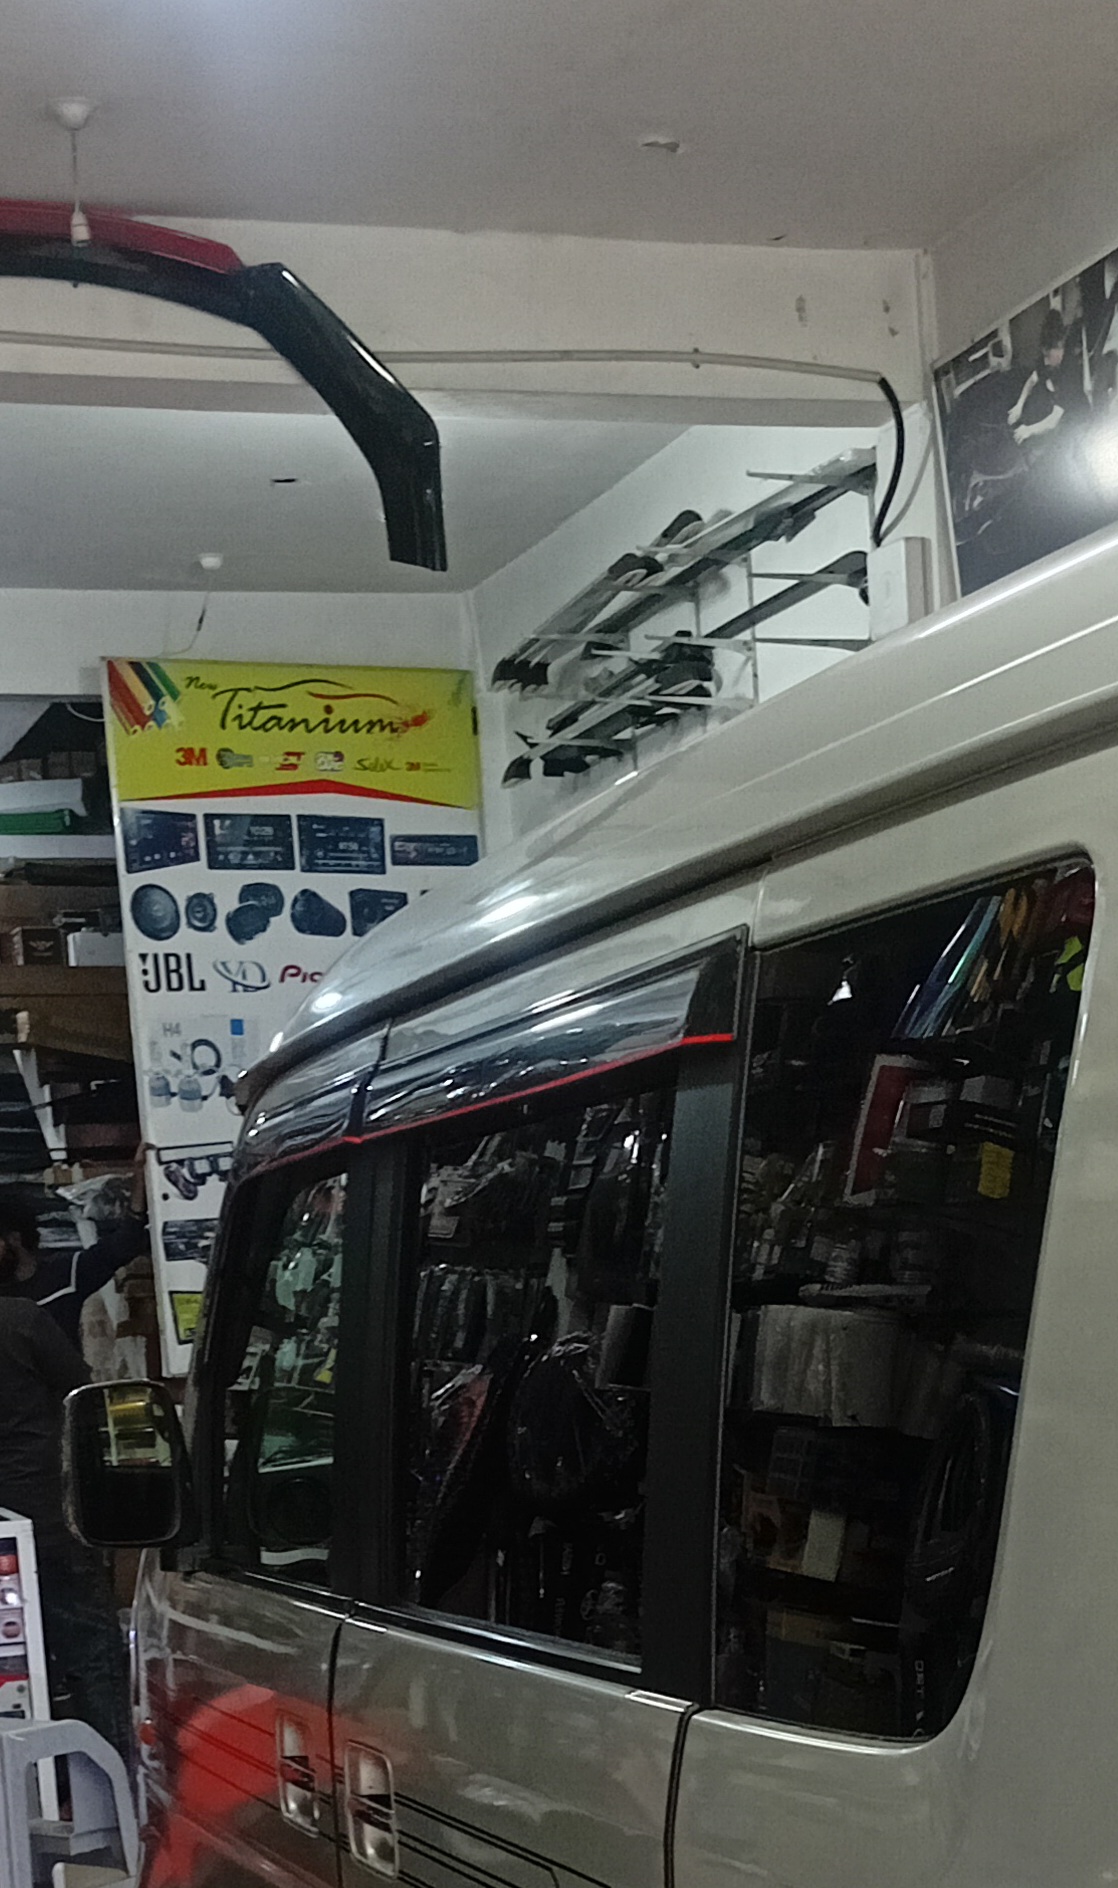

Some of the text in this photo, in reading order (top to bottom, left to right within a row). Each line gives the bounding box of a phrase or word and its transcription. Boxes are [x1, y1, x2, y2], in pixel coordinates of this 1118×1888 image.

[185, 676, 218, 691] New
[211, 687, 400, 734] Titanium
[175, 747, 208, 767] 3M
[139, 953, 207, 993] JBL
[162, 1022, 182, 1038] H4
